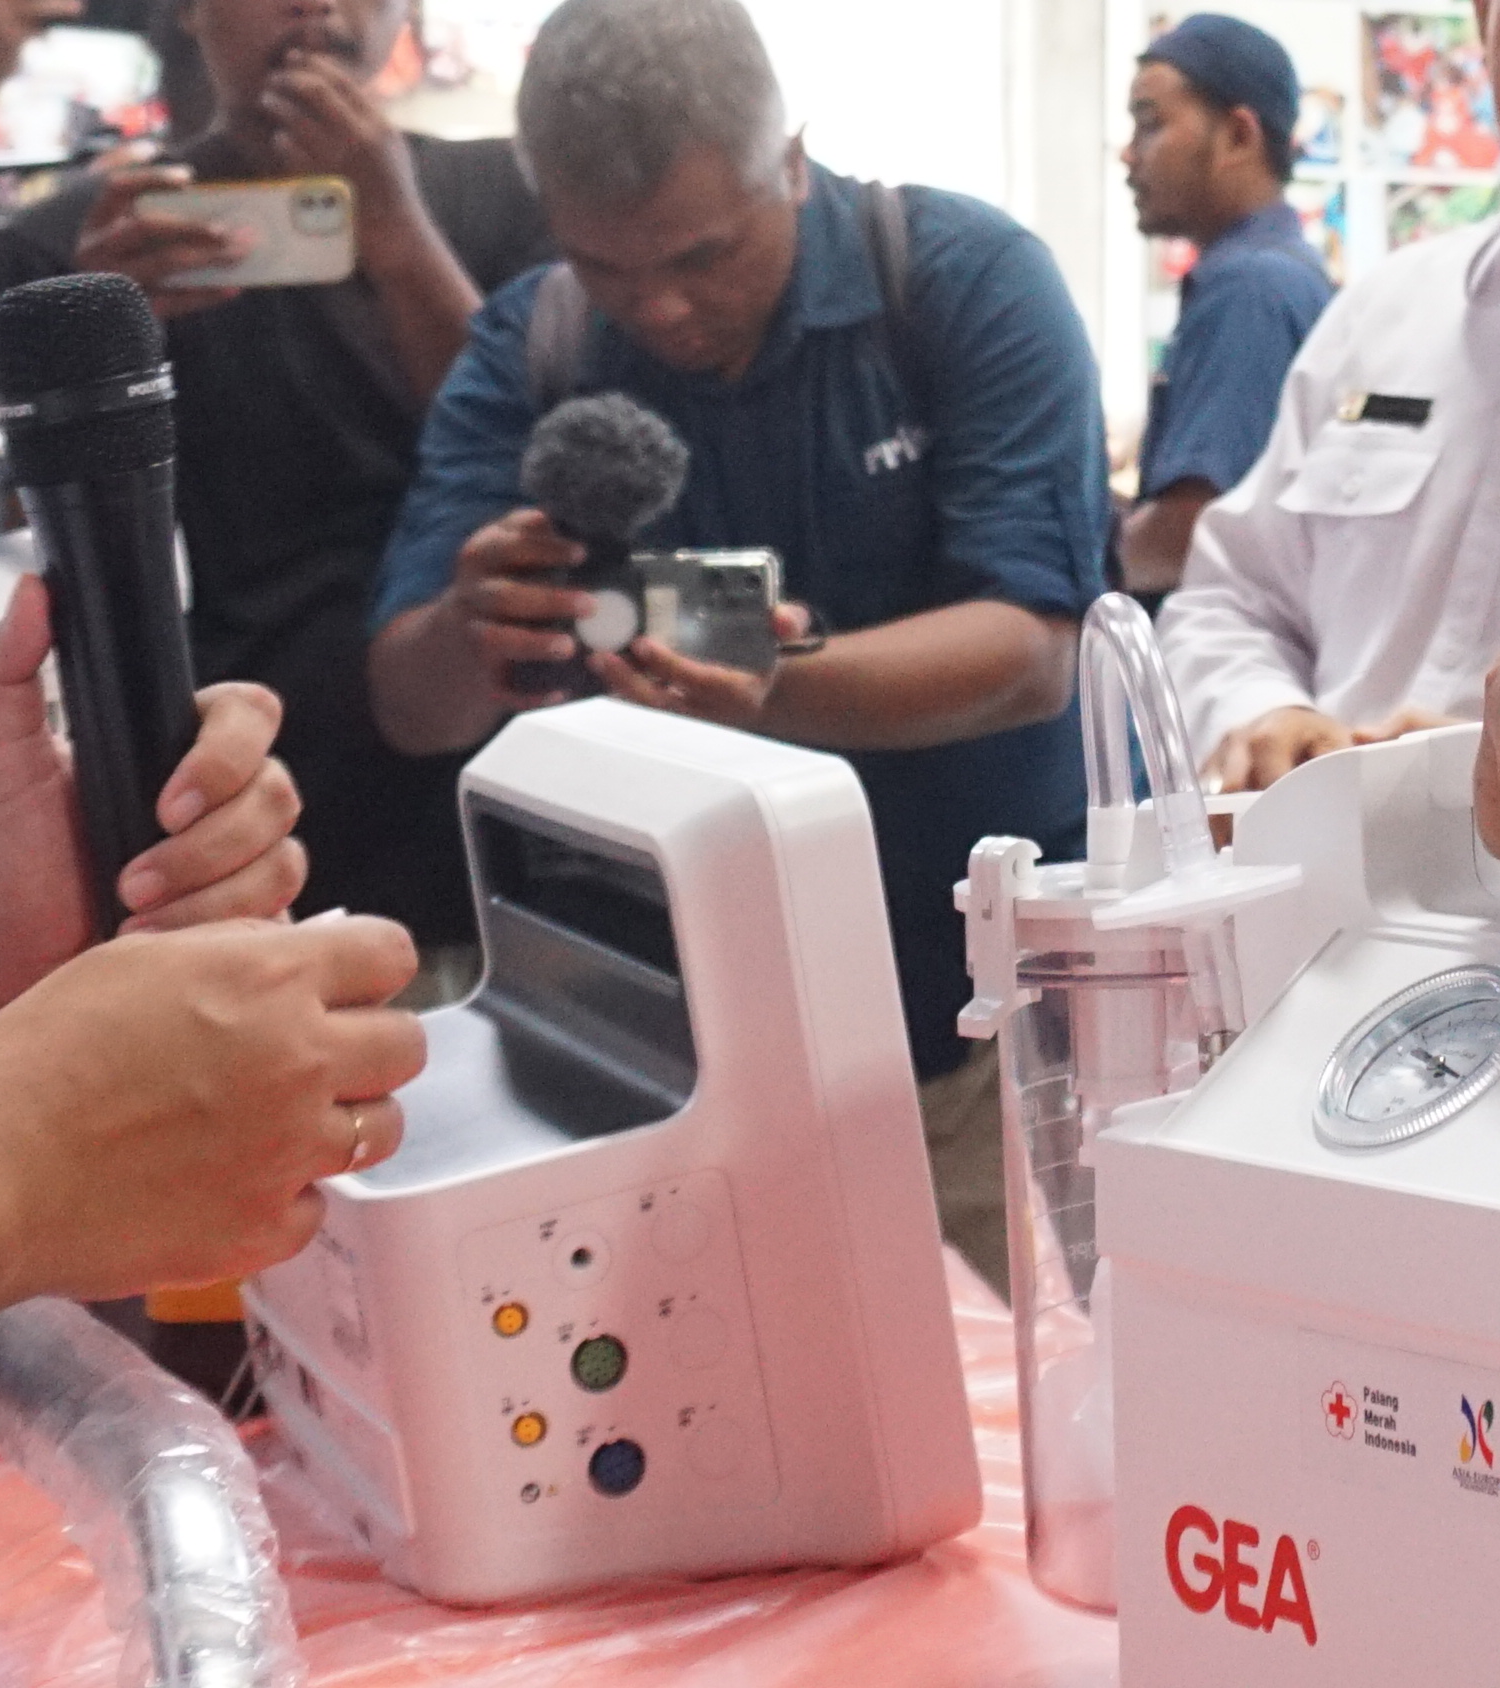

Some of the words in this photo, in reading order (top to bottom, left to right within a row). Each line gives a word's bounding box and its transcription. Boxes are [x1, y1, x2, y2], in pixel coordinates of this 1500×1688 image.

[1363, 1386, 1399, 1412] Palang
[1364, 1410, 1397, 1431] Merah
[1364, 1430, 1417, 1457] Indonesia
[1164, 1504, 1318, 1647] GEA
